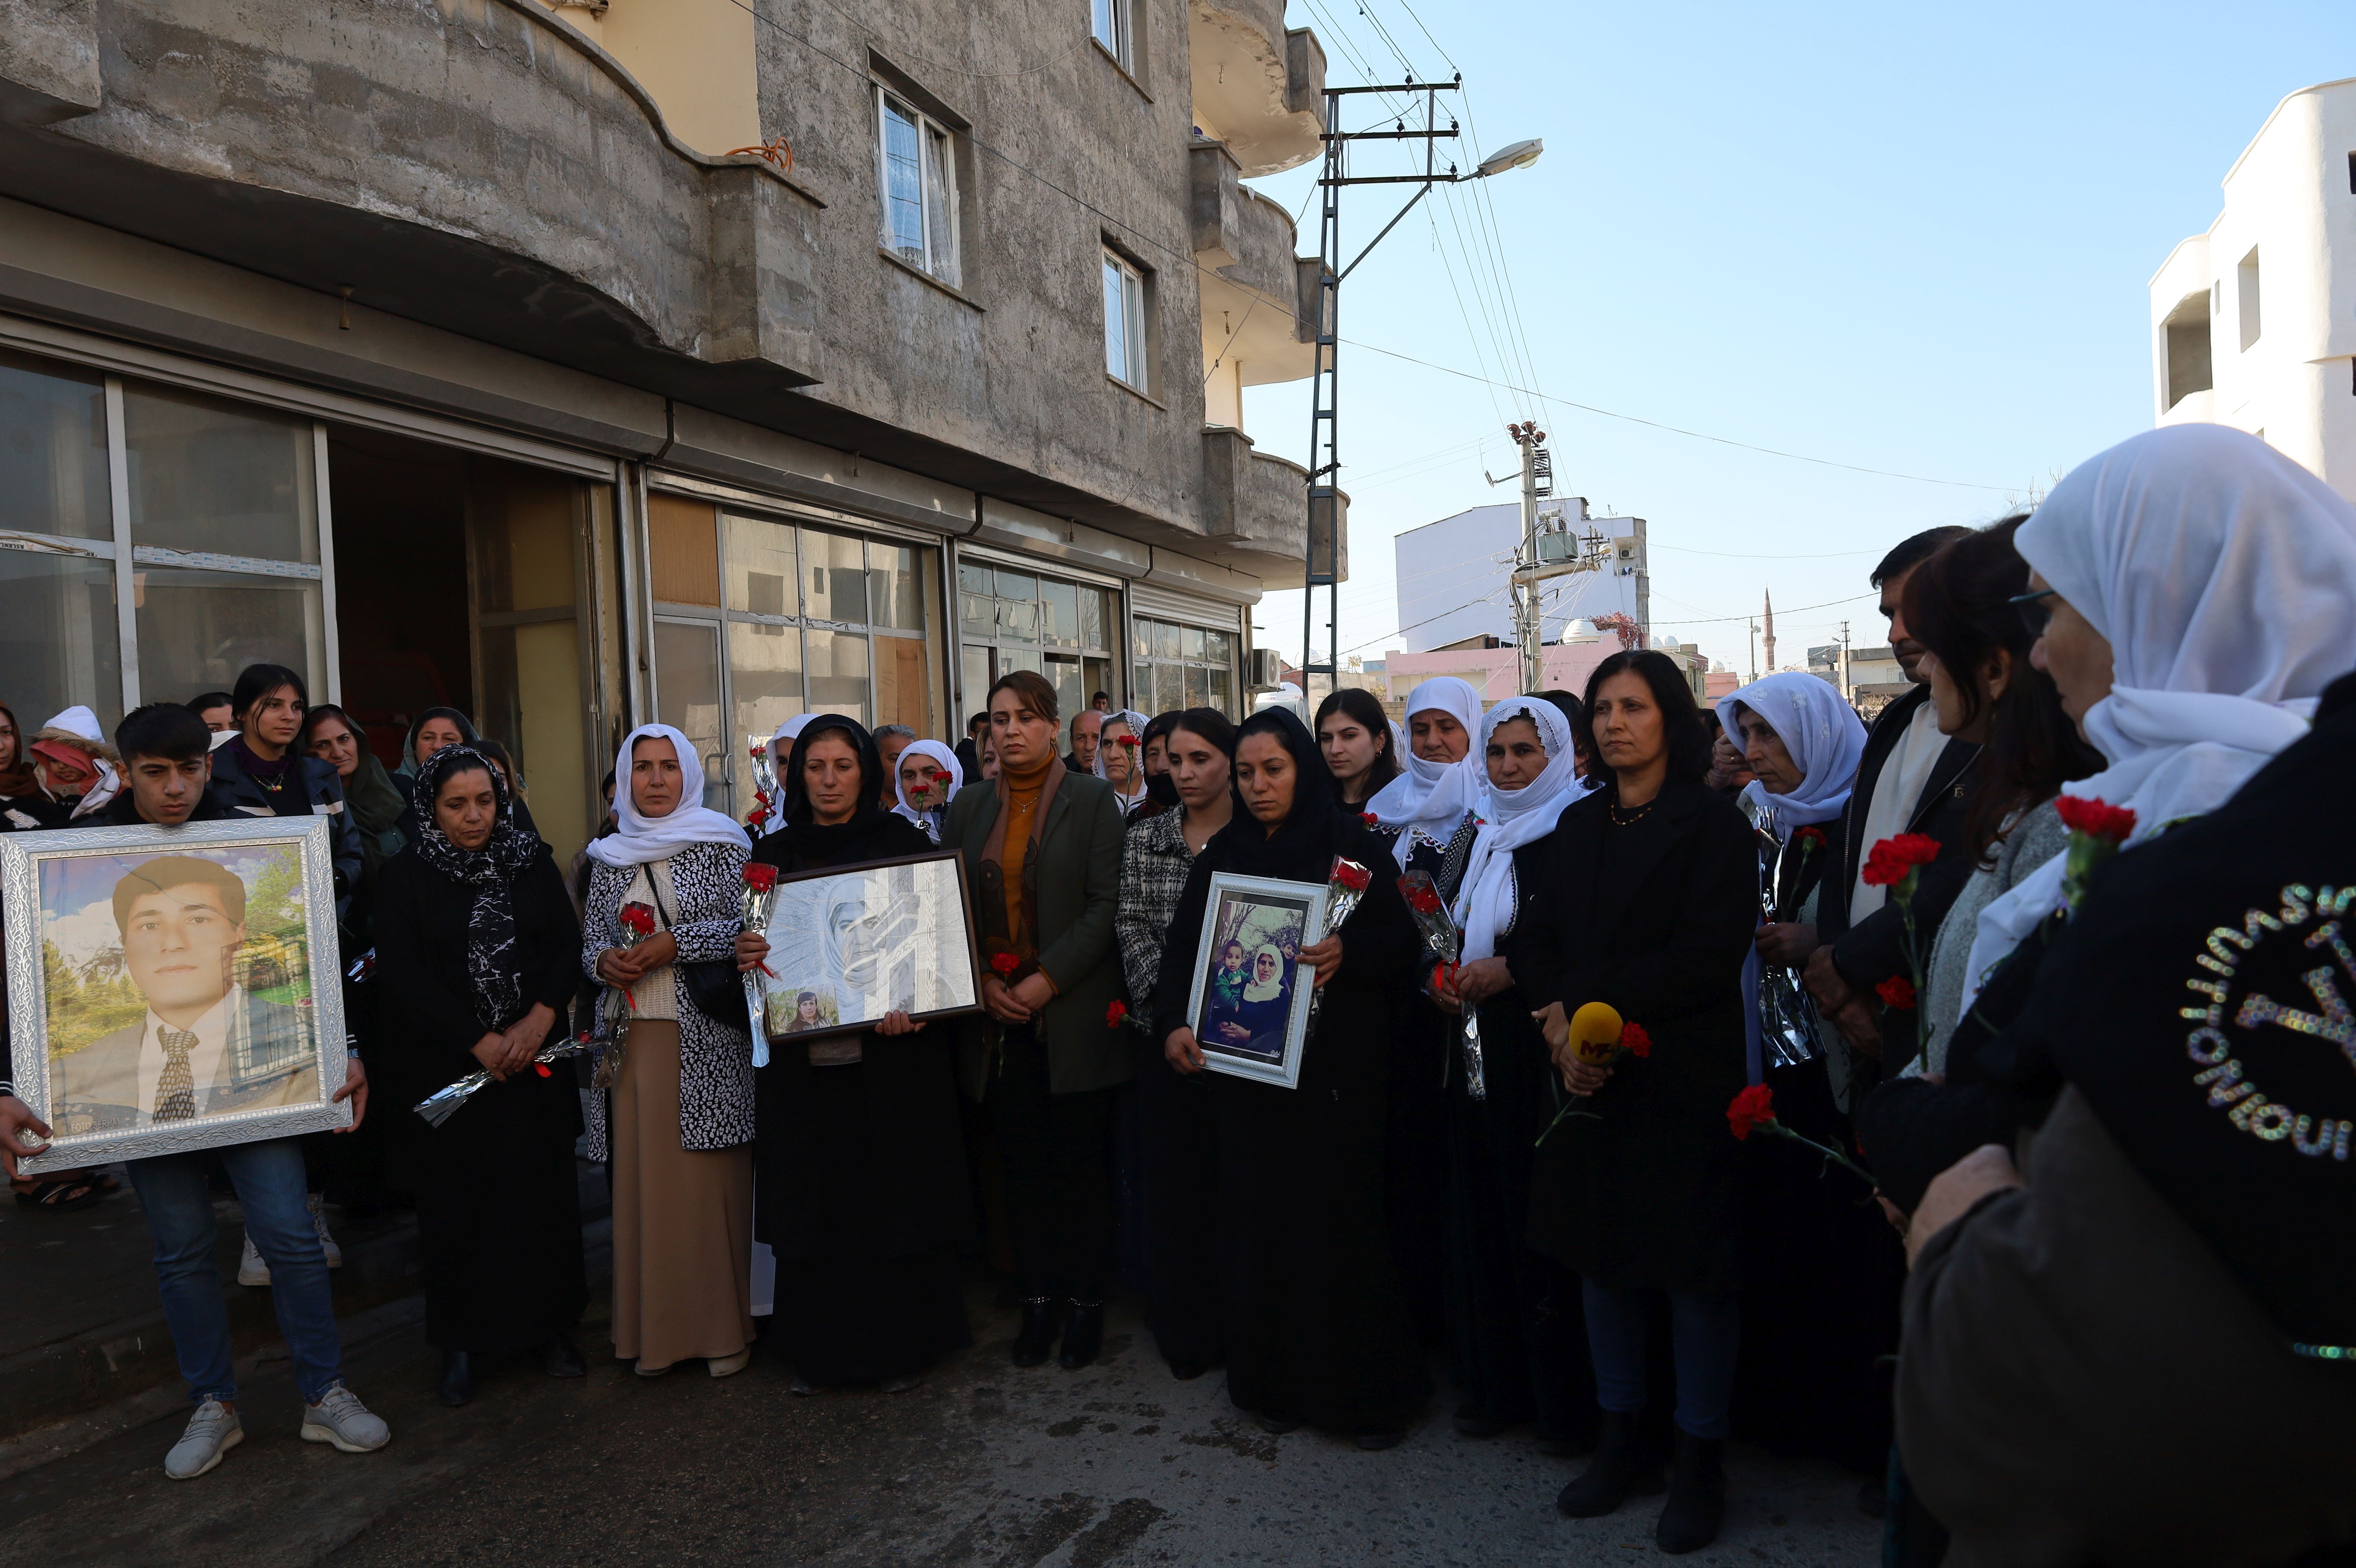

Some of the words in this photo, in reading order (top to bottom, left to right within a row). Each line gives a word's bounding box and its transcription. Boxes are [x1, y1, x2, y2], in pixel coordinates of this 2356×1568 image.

[71, 1122, 91, 1132] FOTO
[92, 1118, 120, 1130] SERHAT
[2228, 1093, 2356, 1161] LOUI
